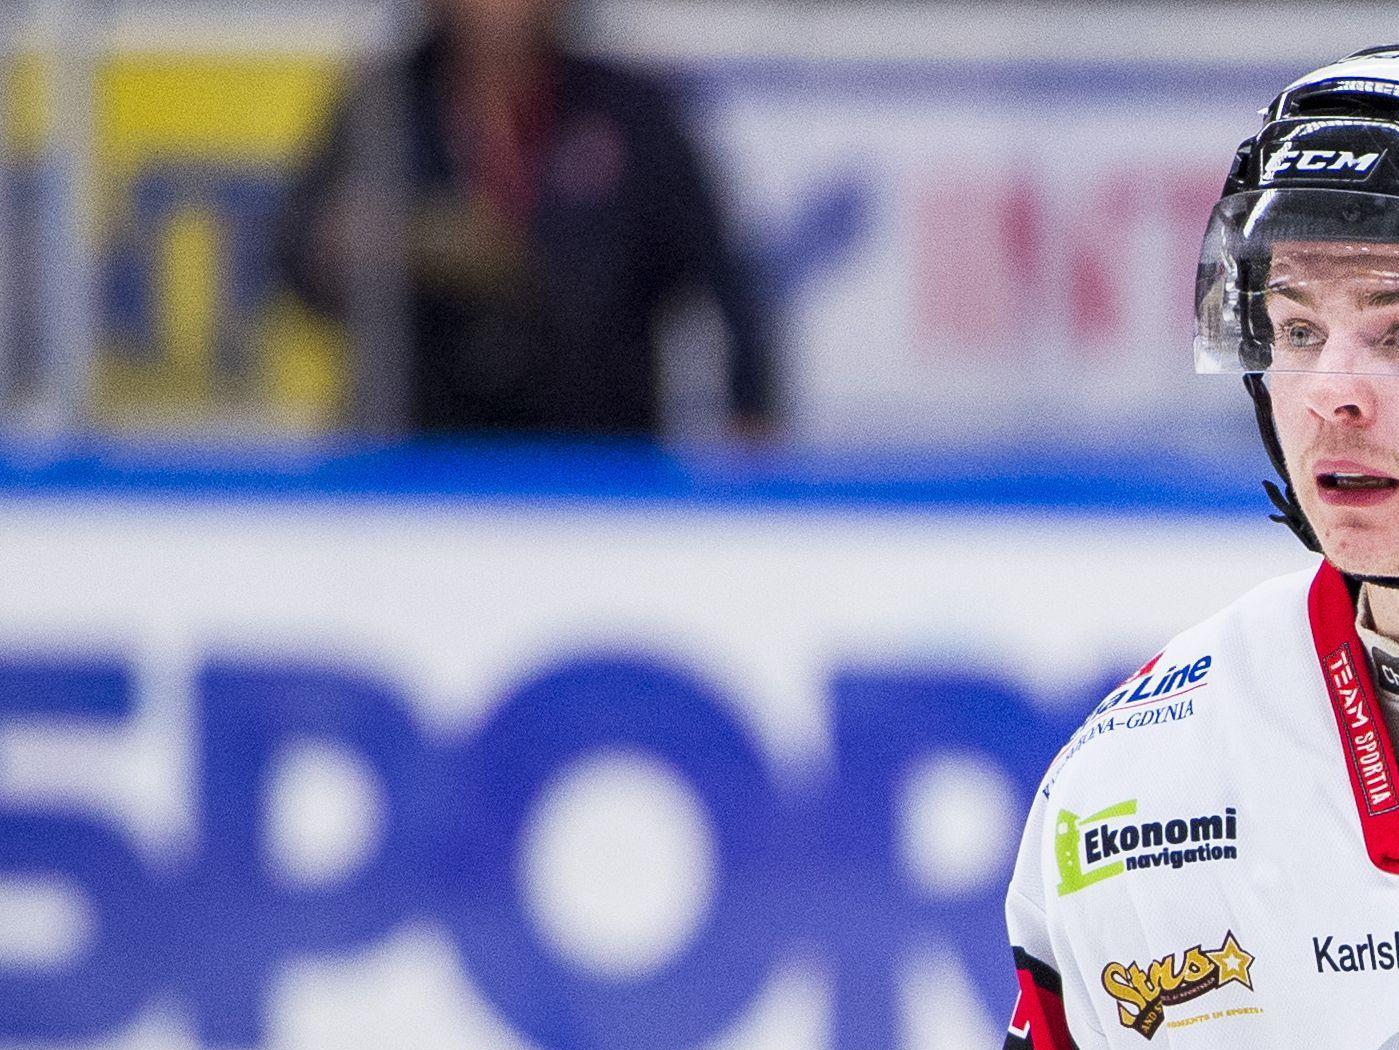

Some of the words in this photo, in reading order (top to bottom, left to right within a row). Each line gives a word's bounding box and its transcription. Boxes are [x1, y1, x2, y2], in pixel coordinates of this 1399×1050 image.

[1126, 655, 1212, 703] Line
[1328, 651, 1369, 728] TEAM
[1354, 731, 1392, 804] SPORTIA
[1084, 807, 1237, 864] Ekonomi
[1126, 843, 1238, 871] navigation
